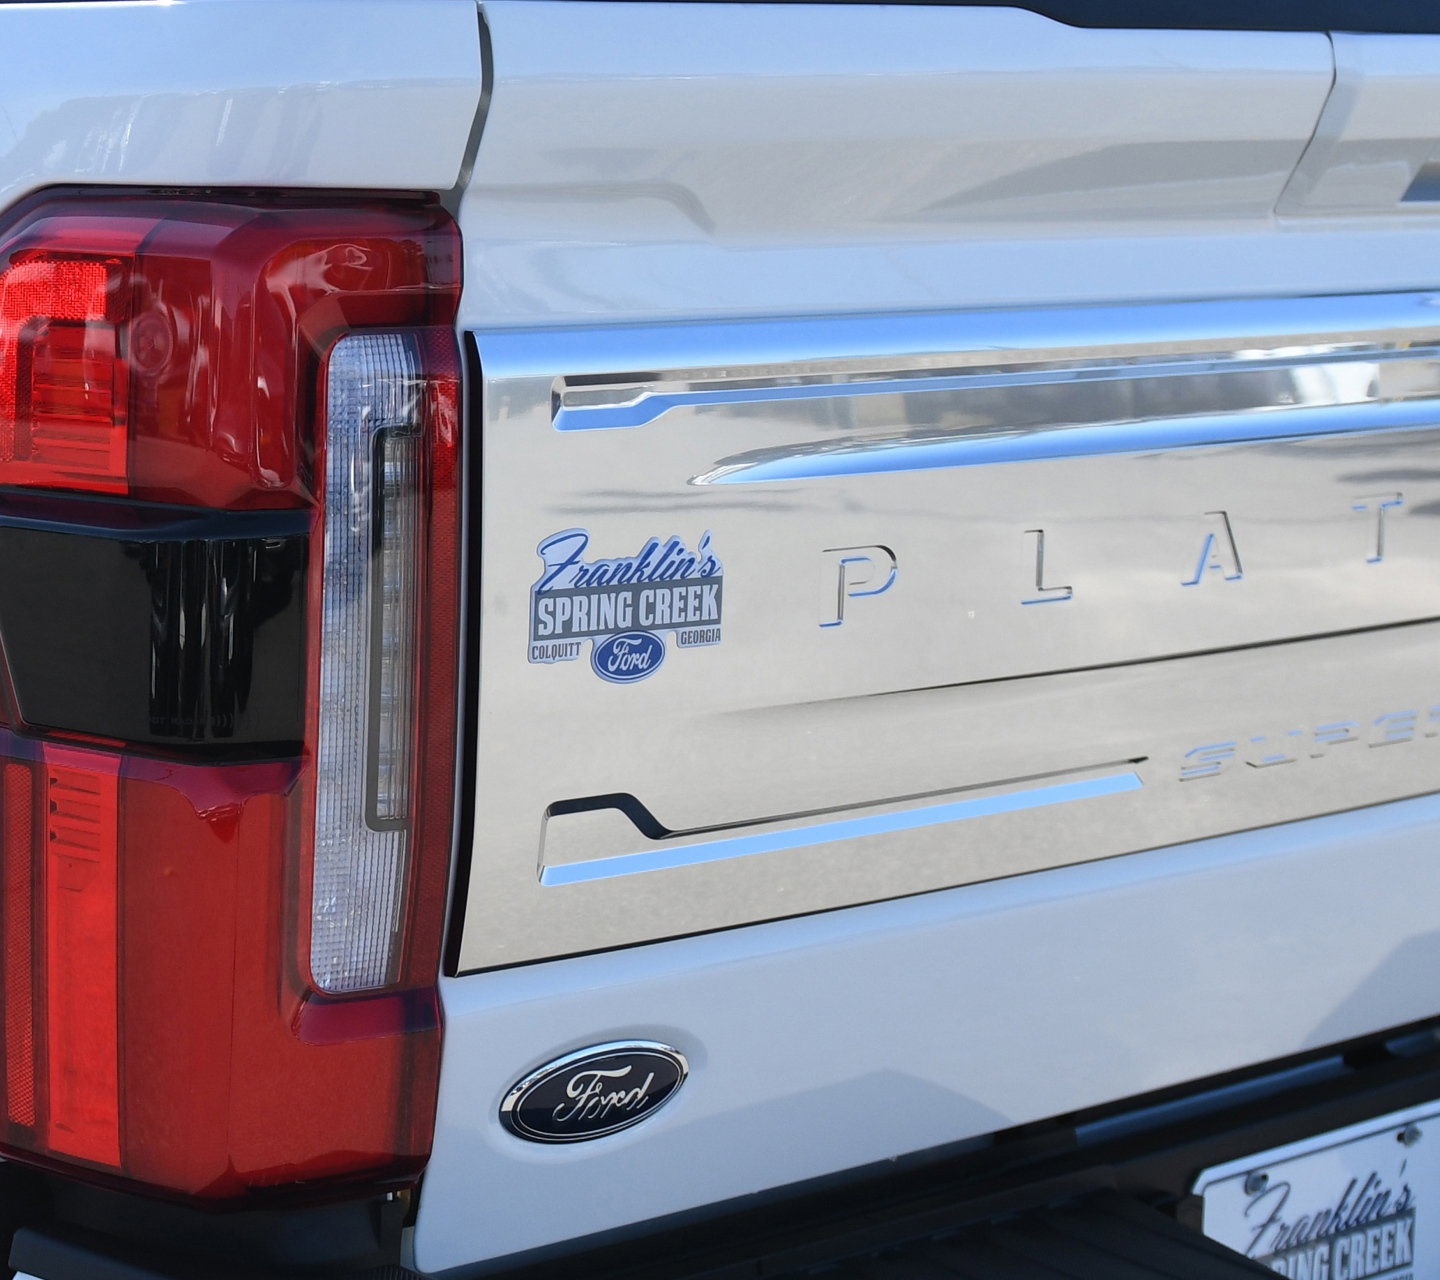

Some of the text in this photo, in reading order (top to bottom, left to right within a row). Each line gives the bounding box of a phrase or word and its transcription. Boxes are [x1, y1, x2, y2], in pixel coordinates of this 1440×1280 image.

[537, 532, 720, 595] Franklin's
[538, 584, 719, 636] SPRING CREEK
[532, 642, 581, 660] COLQUITT
[607, 637, 652, 671] Ford
[680, 628, 721, 645] GEORGIA
[552, 1065, 655, 1122] Ford
[1244, 1158, 1415, 1260] Franklin's
